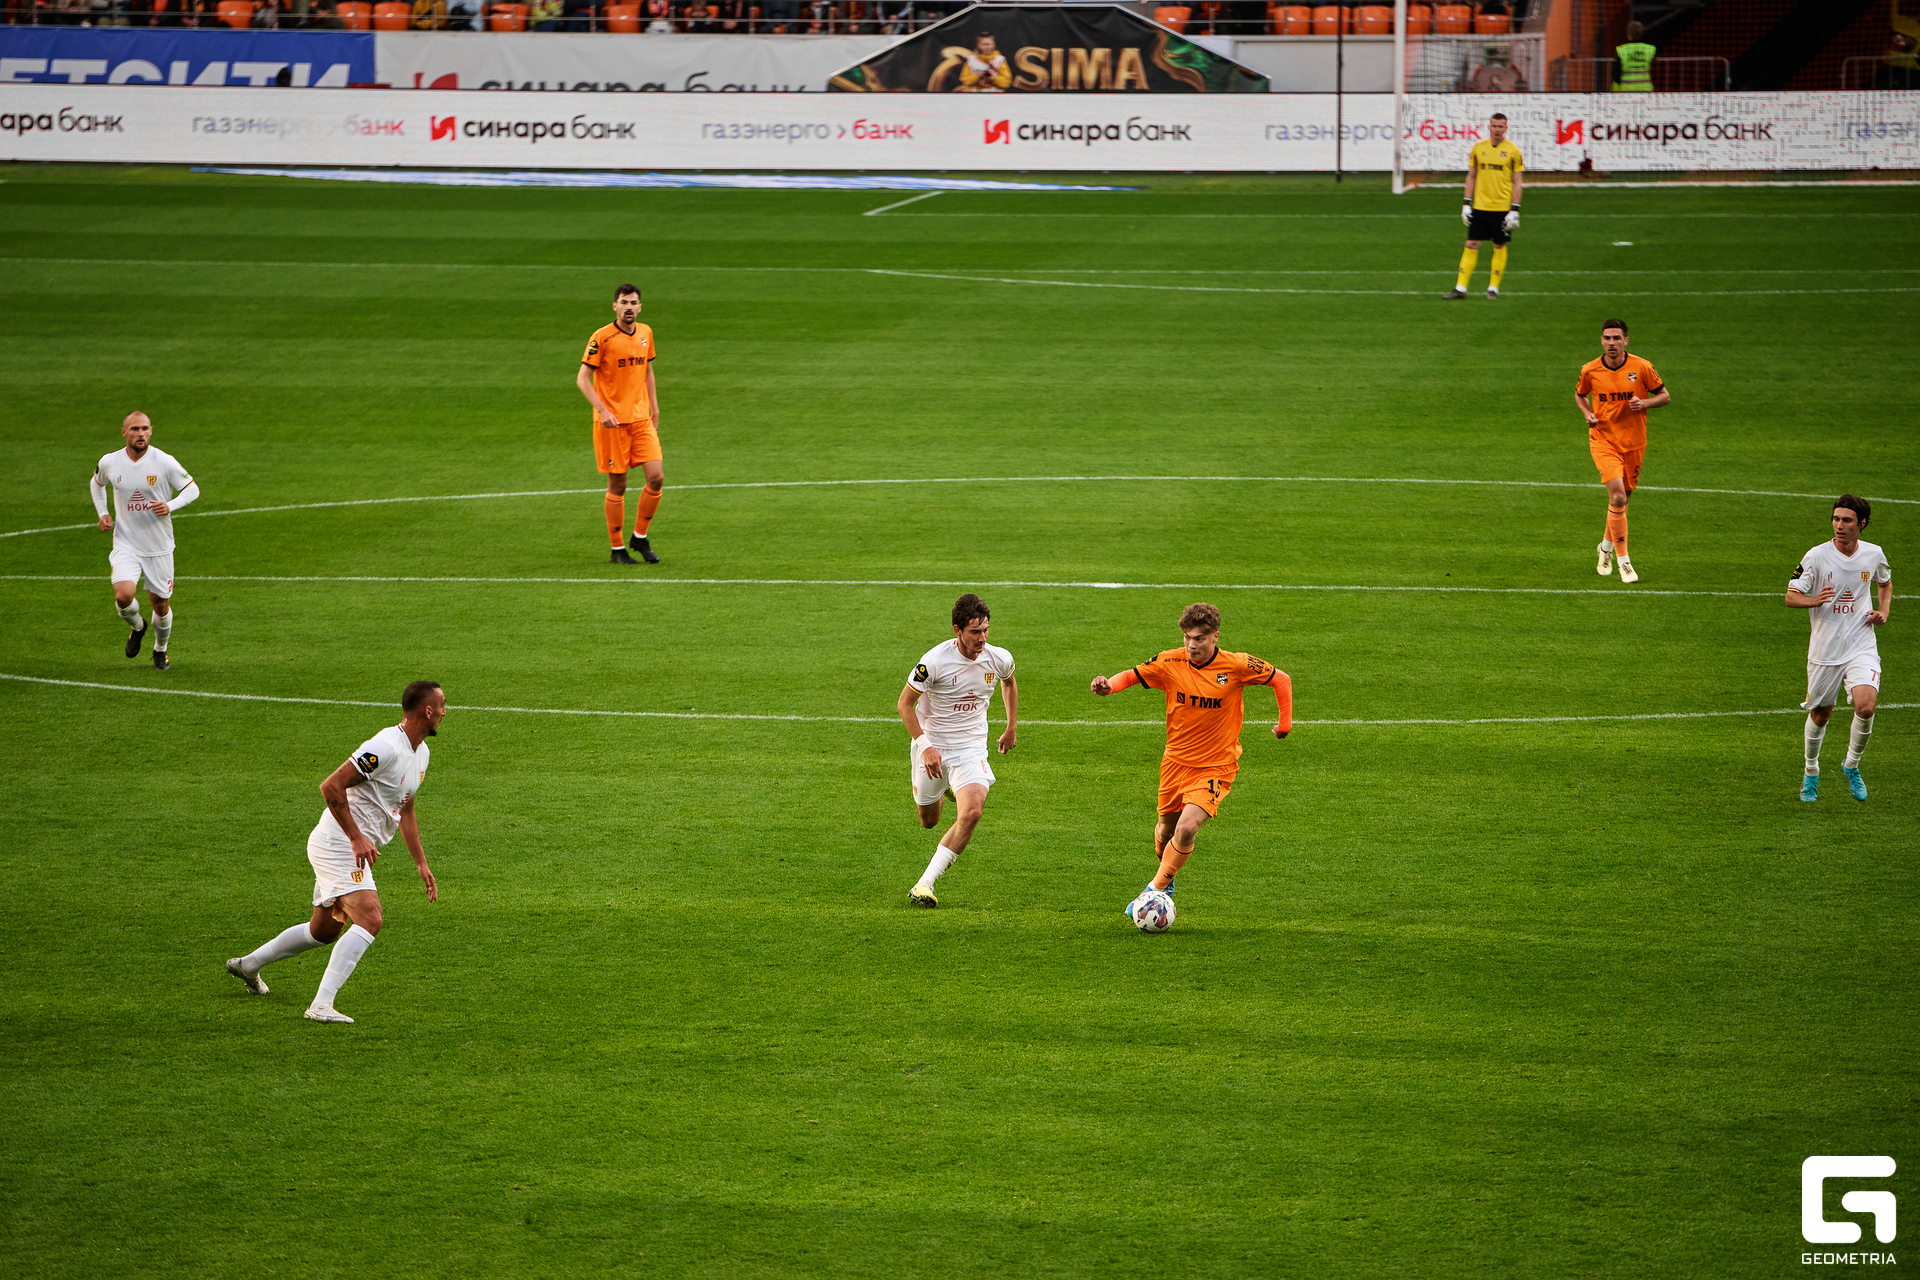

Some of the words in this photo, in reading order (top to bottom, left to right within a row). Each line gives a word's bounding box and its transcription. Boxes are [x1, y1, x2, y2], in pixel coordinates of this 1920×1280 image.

[1012, 46, 1150, 91] SIMA
[58, 106, 125, 133] банк
[343, 113, 405, 136] банк
[463, 119, 566, 143] синара
[571, 114, 638, 140] банк
[701, 122, 831, 144] газэнерго
[852, 118, 915, 140] банк
[1017, 123, 1121, 146] синара
[1126, 116, 1193, 142] банк
[1264, 123, 1397, 146] газэнерго
[1418, 119, 1484, 142] банк
[1590, 120, 1699, 146] синара
[1704, 114, 1775, 141] банк
